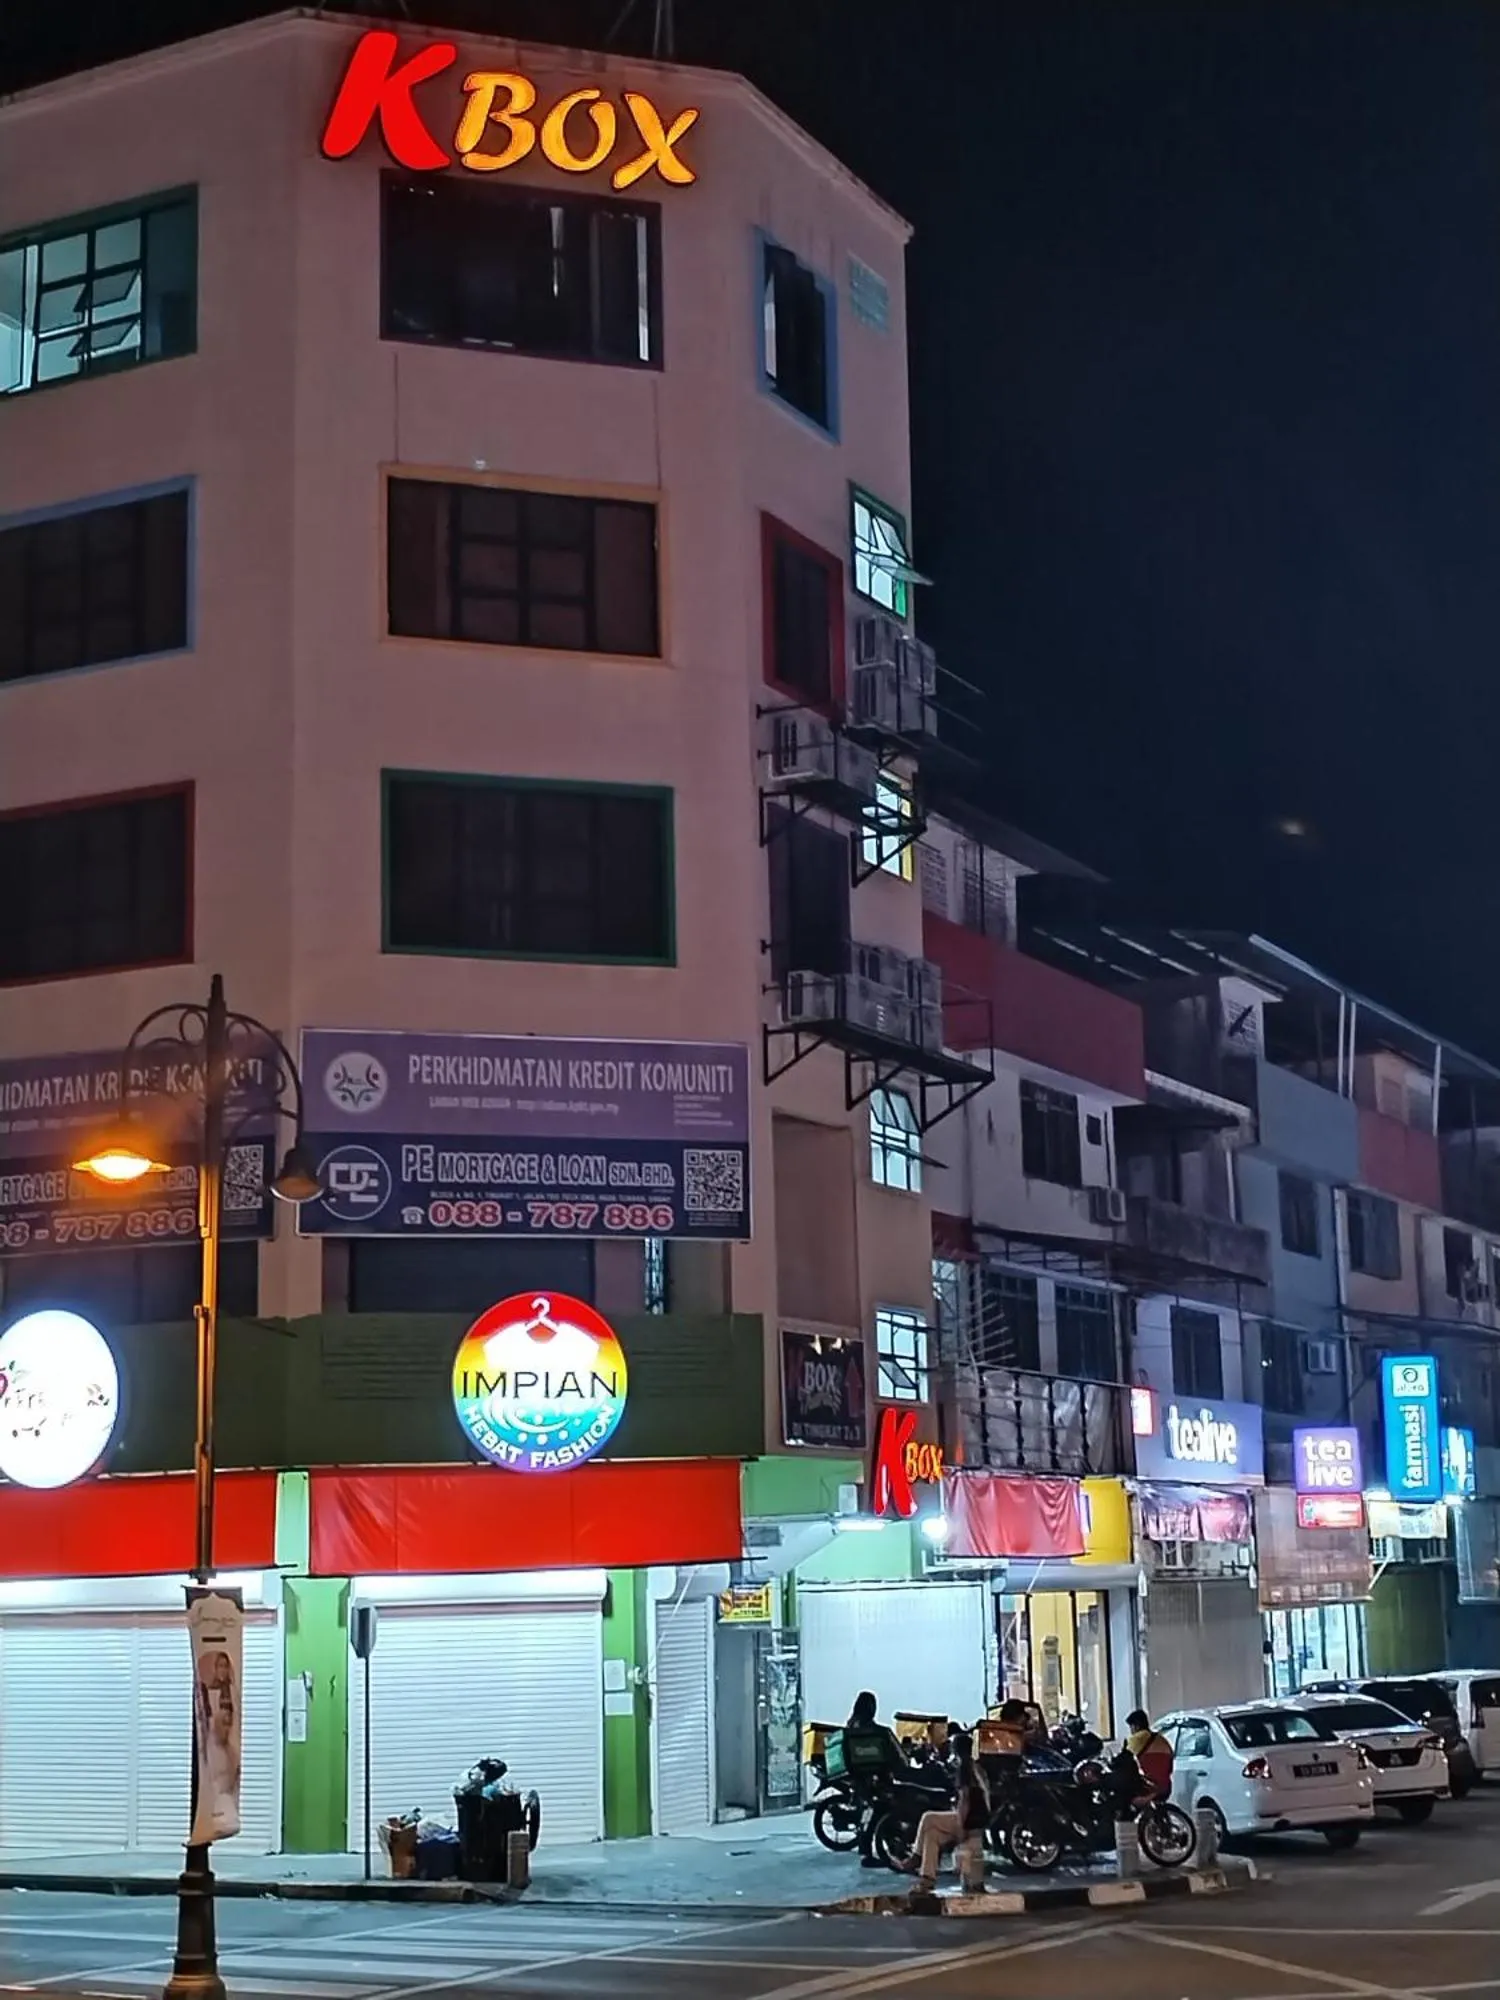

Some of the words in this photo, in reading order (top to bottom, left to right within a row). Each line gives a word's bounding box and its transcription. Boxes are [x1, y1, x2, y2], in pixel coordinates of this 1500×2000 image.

[321, 30, 457, 170] K
[453, 70, 700, 190] BOX
[408, 1055, 562, 1088] PERKHIDMATAN
[568, 1061, 634, 1090] KREDIT
[640, 1063, 734, 1094] KOMUNITI
[402, 1145, 433, 1181] PE
[438, 1151, 539, 1184] MORTGAGE
[541, 1155, 556, 1184] &
[557, 1156, 607, 1185] LOAN
[609, 1162, 641, 1187] SDN.
[643, 1164, 675, 1187] BHD.
[54, 1214, 122, 1243] 787
[126, 1208, 196, 1238] 886
[429, 1200, 502, 1227] 088
[528, 1202, 598, 1229] 787
[603, 1204, 674, 1231] 886
[461, 1372, 617, 1400] IMPIAN
[804, 1361, 837, 1394] BOX
[463, 1405, 523, 1464] HEBAT
[530, 1404, 614, 1468] FASHION
[1167, 1404, 1237, 1465] tealive
[1303, 1436, 1351, 1460] tea
[1399, 1404, 1424, 1488] farmasi
[874, 1406, 917, 1518] K
[905, 1441, 943, 1483] BOX
[1307, 1462, 1353, 1488] live
